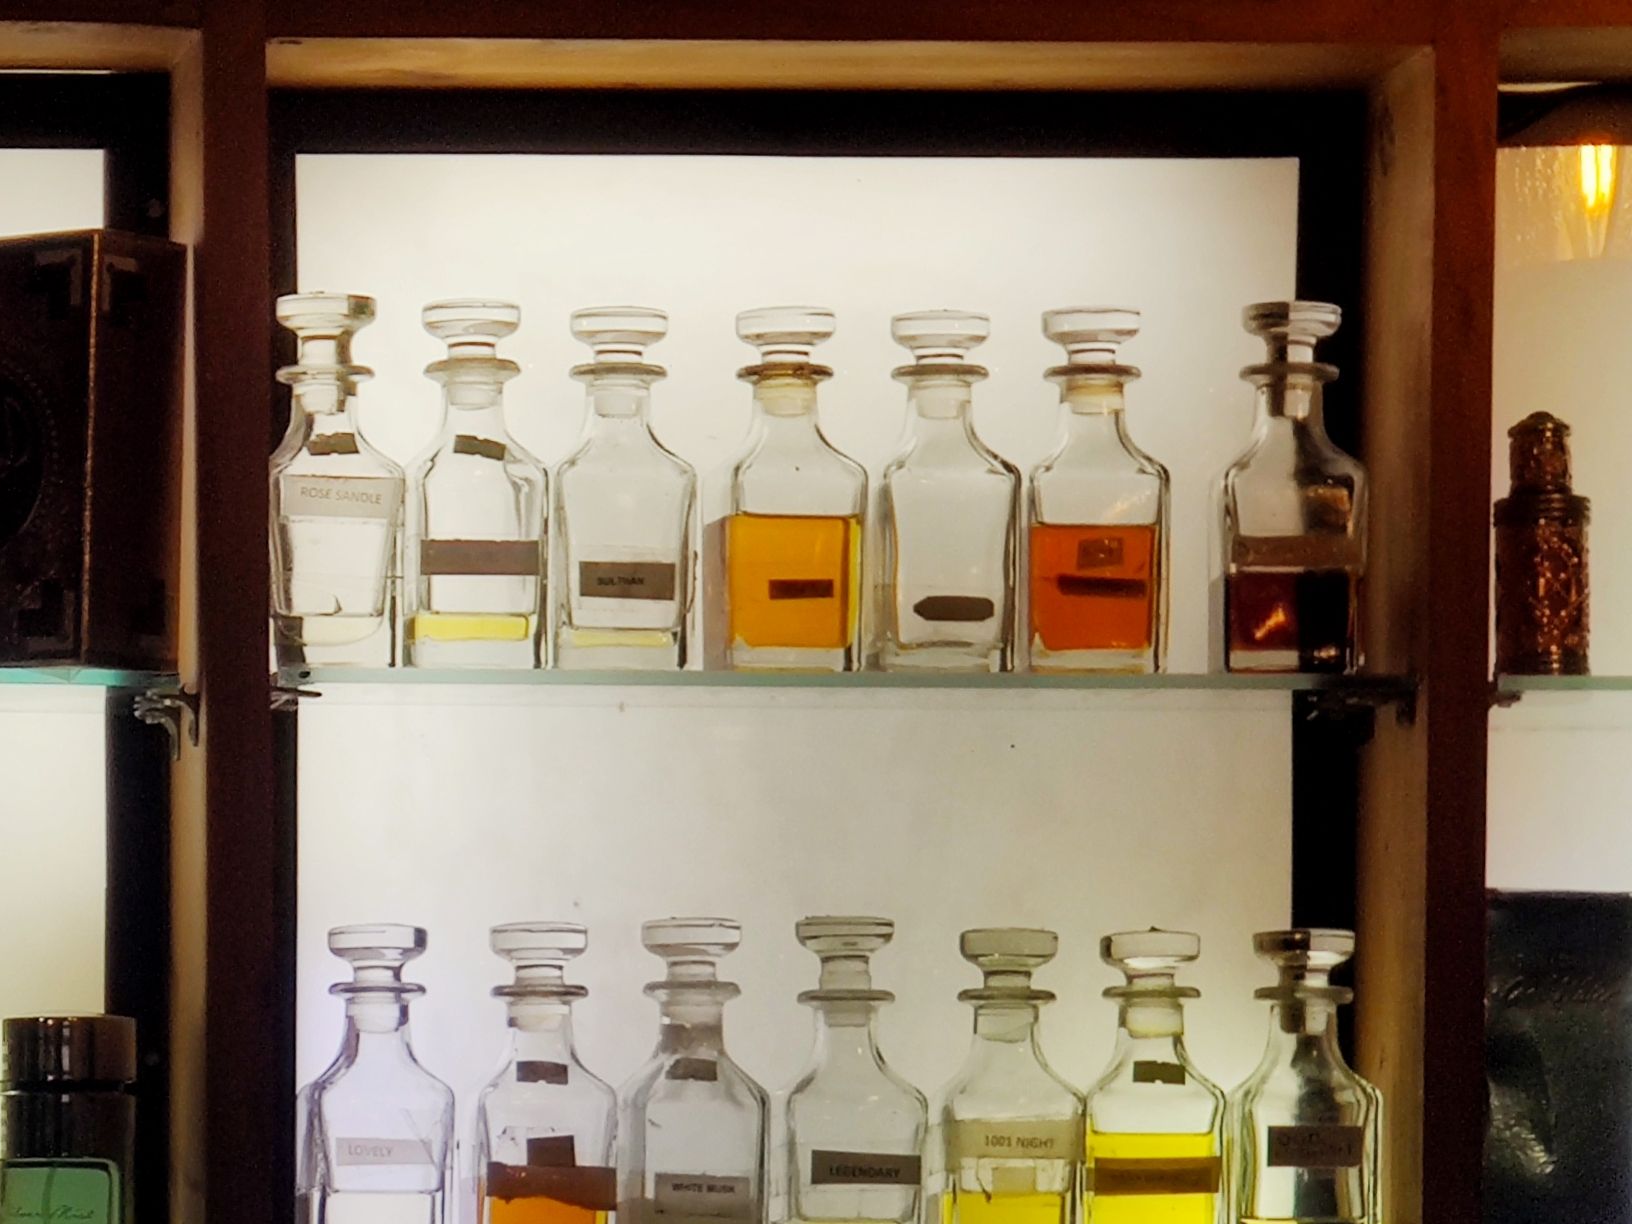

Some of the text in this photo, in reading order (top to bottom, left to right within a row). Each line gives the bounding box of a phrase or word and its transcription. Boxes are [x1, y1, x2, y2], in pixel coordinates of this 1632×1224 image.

[299, 486, 382, 504] ROSE SANDLE
[984, 1135, 1055, 1149] 1001 NIGHT
[347, 1143, 393, 1158] LOVELY
[828, 1164, 901, 1177] LEGENDARY
